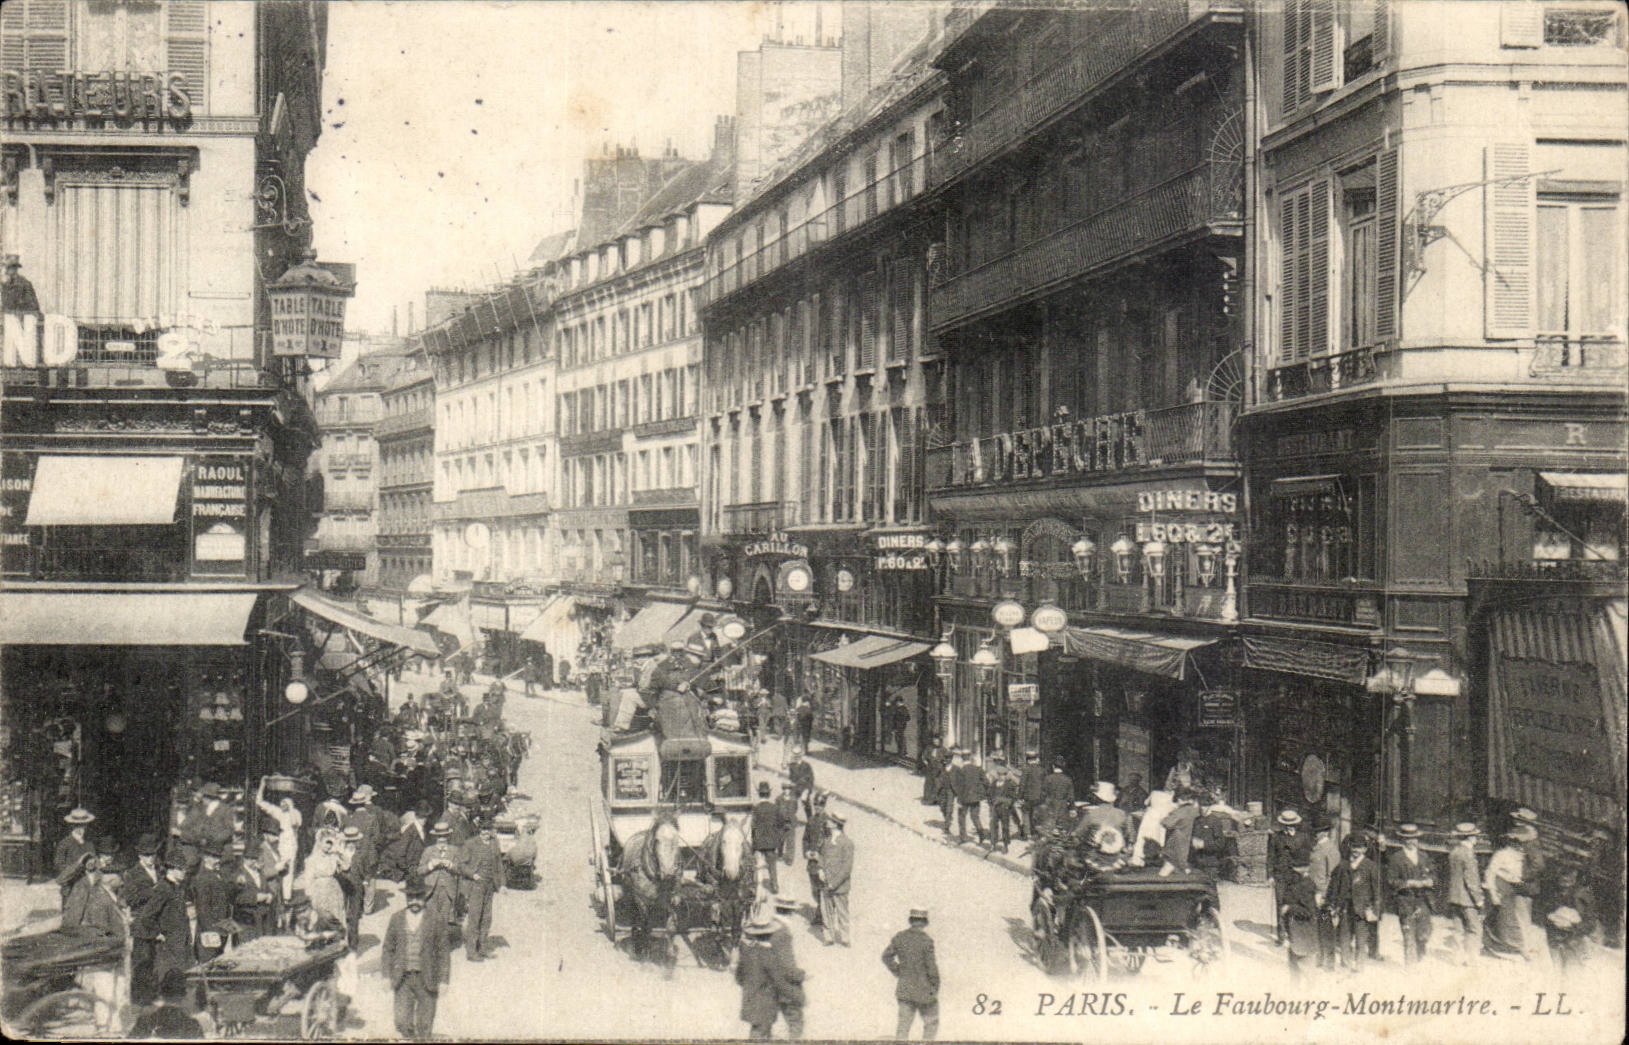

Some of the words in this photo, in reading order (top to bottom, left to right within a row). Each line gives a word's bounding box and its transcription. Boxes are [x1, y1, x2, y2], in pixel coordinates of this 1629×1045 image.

[274, 298, 305, 314] TABLE
[312, 297, 343, 318] TABLE
[198, 466, 244, 480] RAOUL
[0, 478, 31, 491] ISON
[1137, 490, 1237, 512] DINERS
[193, 503, 247, 517] FRANÇAISE
[772, 532, 789, 542] AU
[878, 535, 925, 549] DINERS
